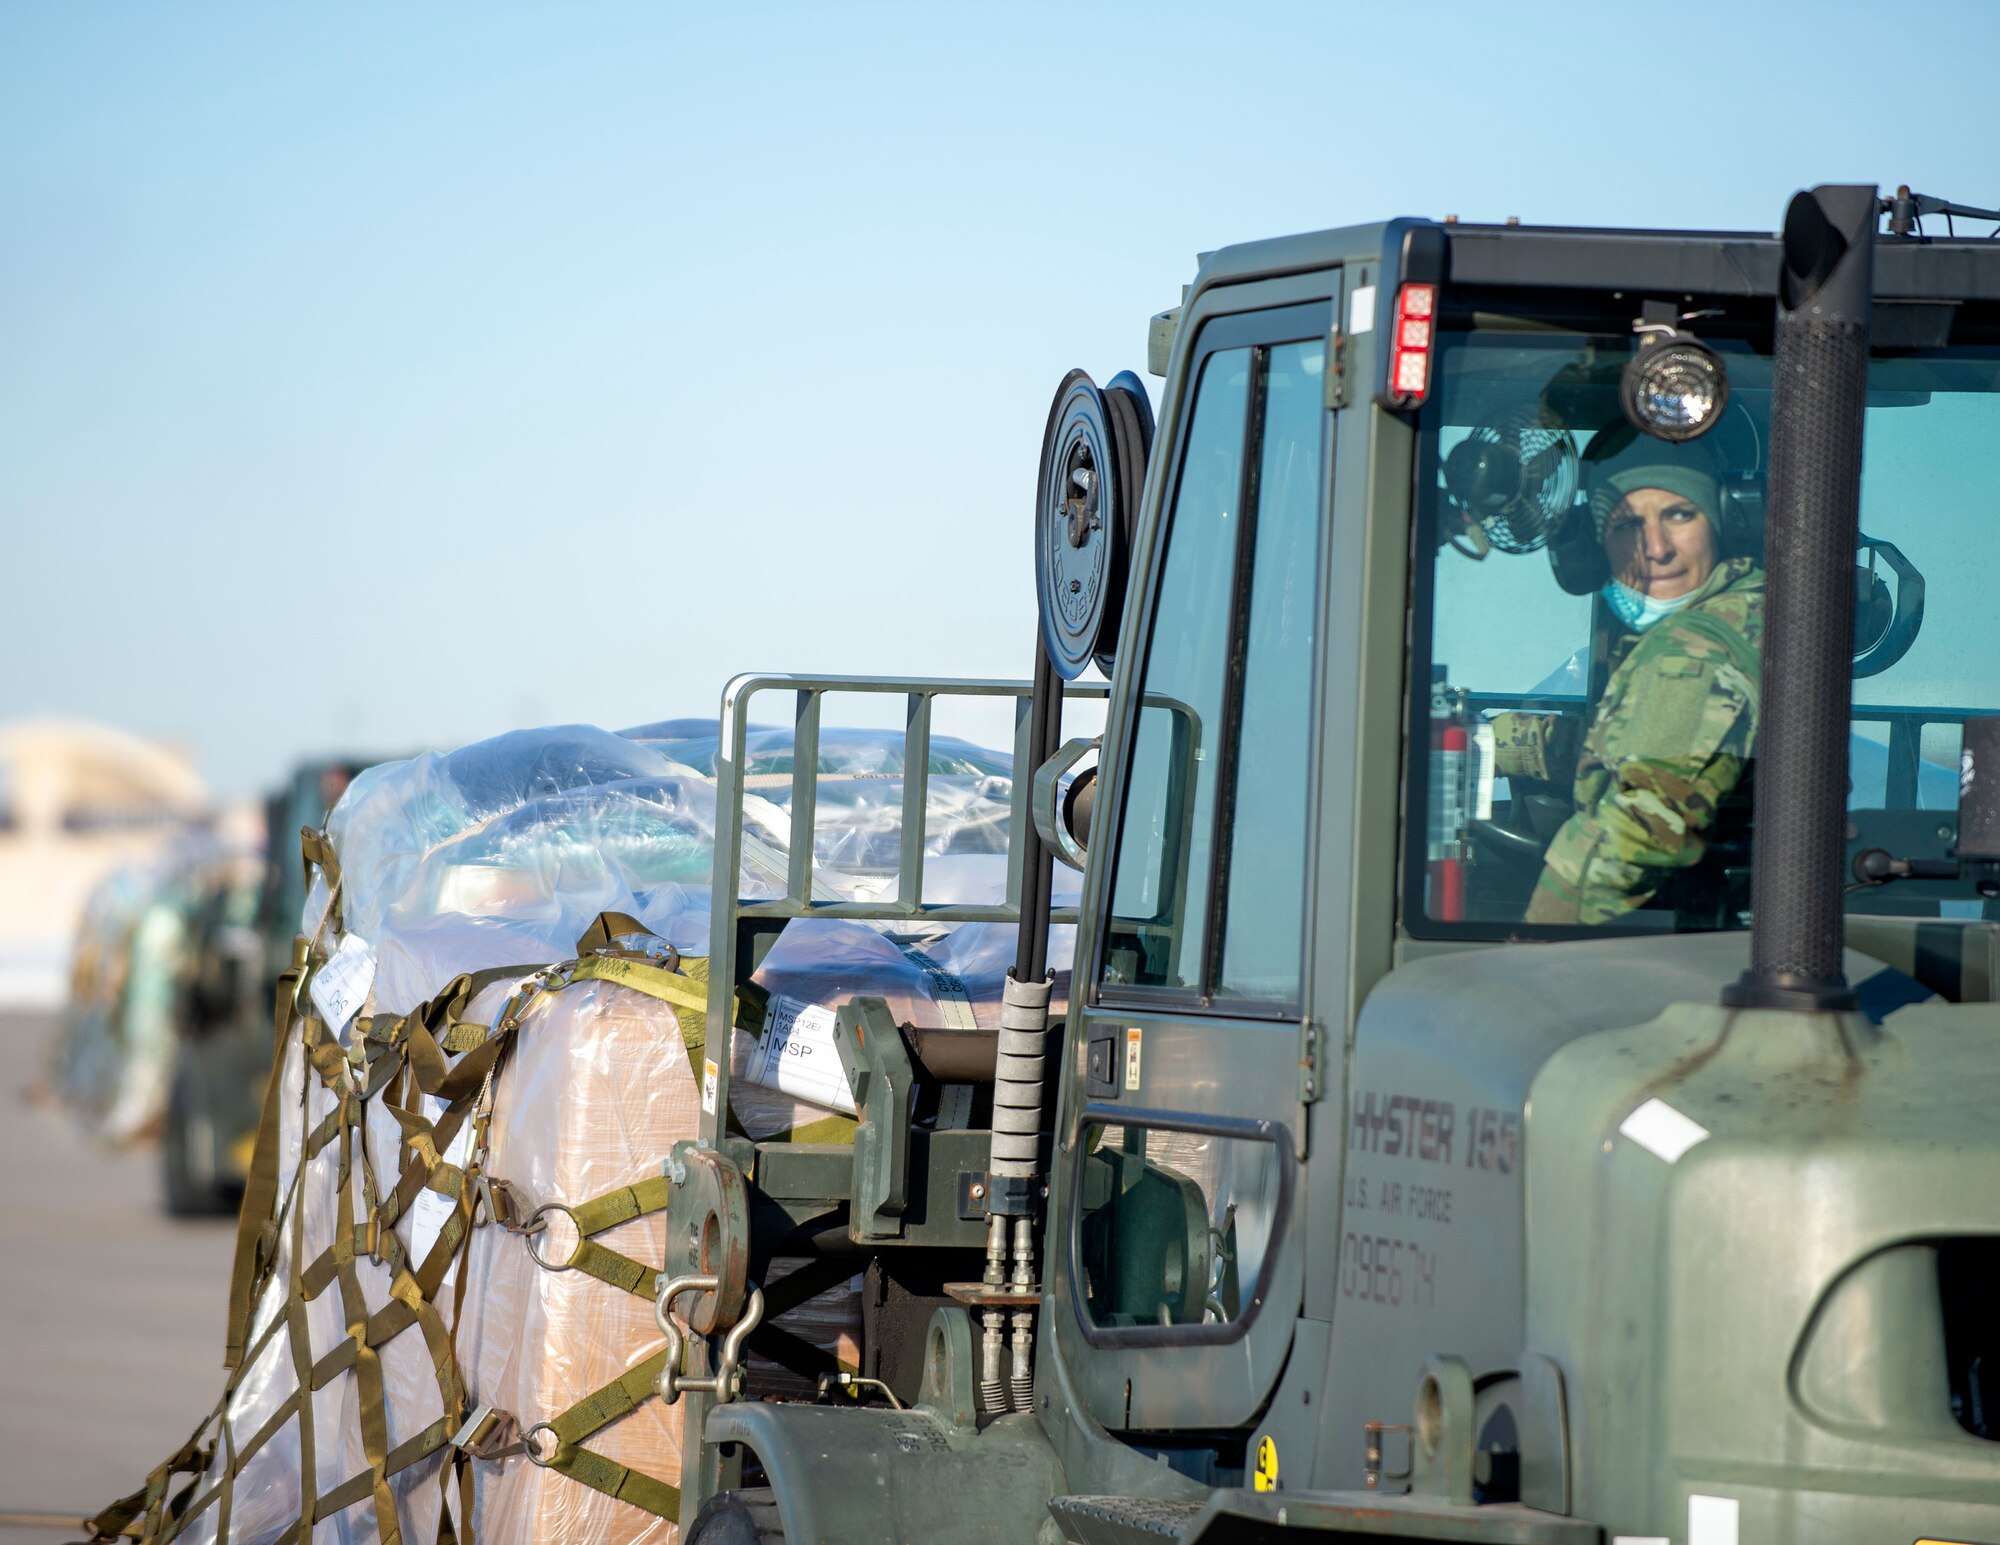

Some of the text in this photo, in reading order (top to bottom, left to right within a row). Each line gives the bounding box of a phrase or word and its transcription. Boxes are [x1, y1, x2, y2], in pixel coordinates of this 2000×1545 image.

[329, 989, 349, 1017] CHS
[773, 1037, 812, 1058] MSP
[1350, 1090, 1456, 1164] HYSTER
[1347, 1175, 1453, 1224] U.S. AIR FORCE
